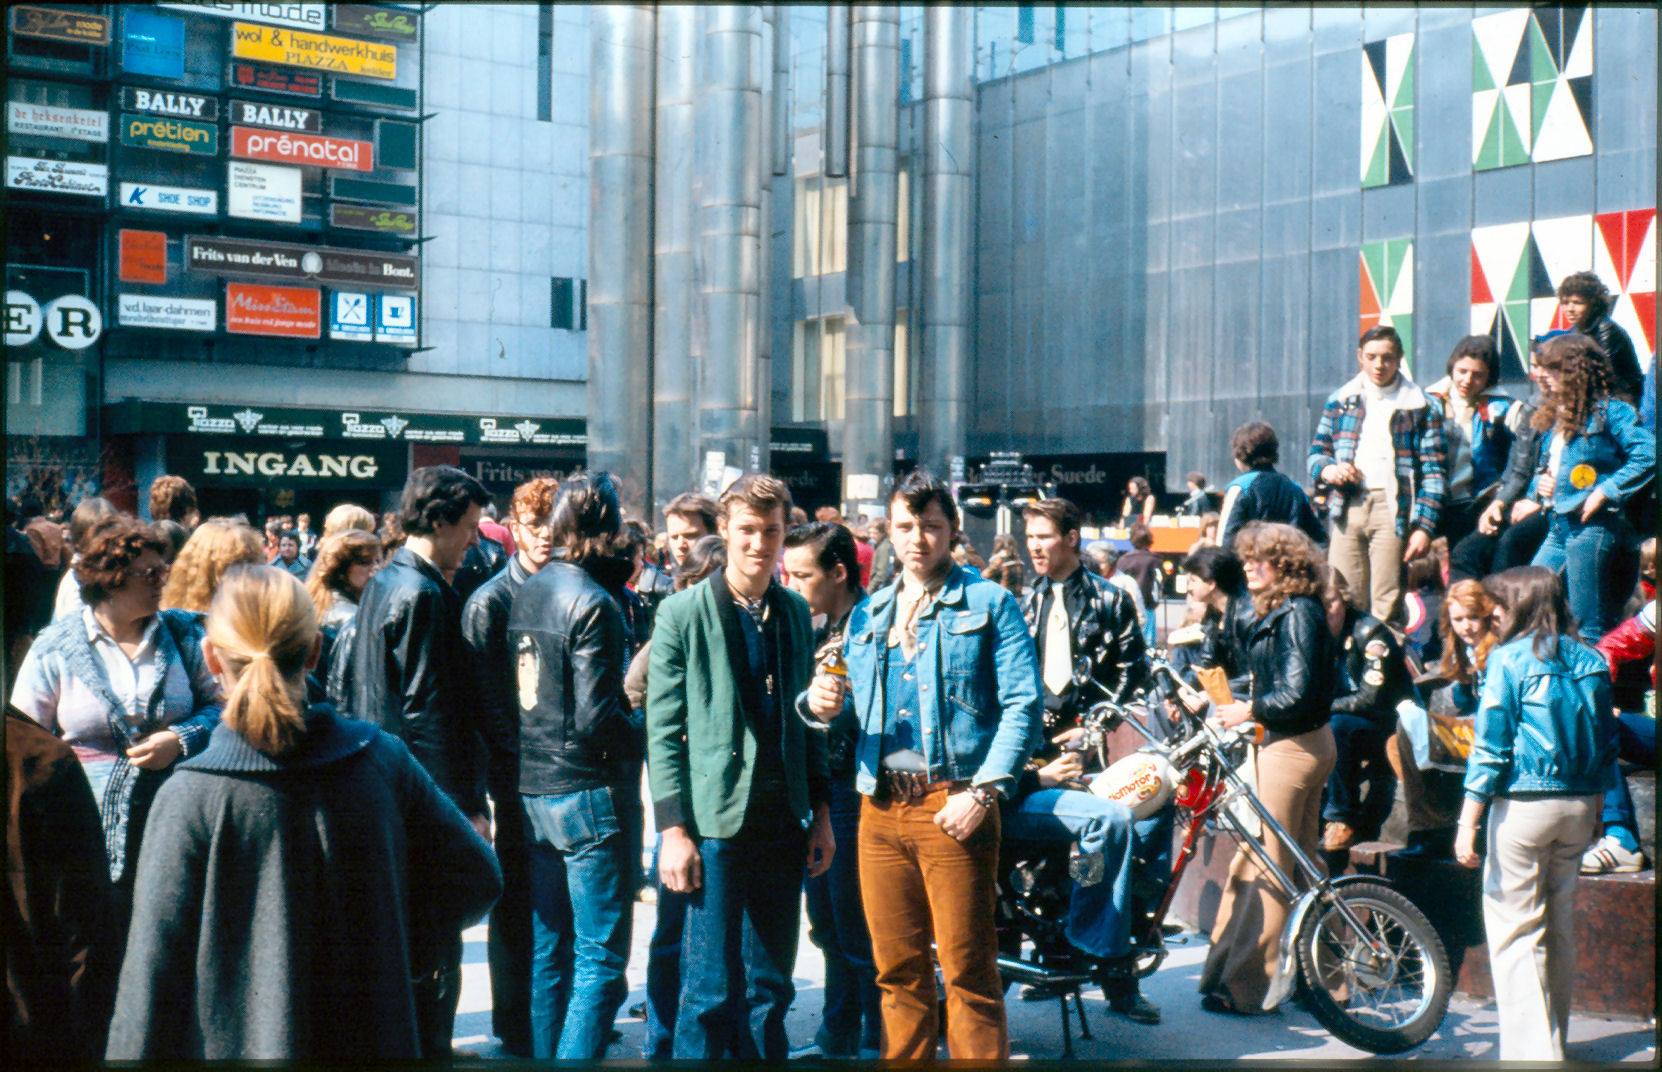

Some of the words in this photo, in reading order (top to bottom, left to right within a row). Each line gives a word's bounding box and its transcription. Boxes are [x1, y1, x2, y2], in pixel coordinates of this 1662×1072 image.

[236, 29, 262, 43] wol
[270, 29, 283, 47] &
[289, 34, 395, 63] handwerkhuis
[285, 51, 348, 71] PIAZZA
[135, 90, 205, 116] BALLY
[242, 104, 309, 129] BALLY
[247, 134, 359, 163] prénatal
[129, 187, 147, 205] K
[192, 246, 225, 261] Frits
[226, 251, 250, 264] van
[251, 251, 275, 266] der
[274, 251, 298, 269] Ven
[203, 451, 379, 478] INGANG
[1051, 464, 1107, 484] Suede
